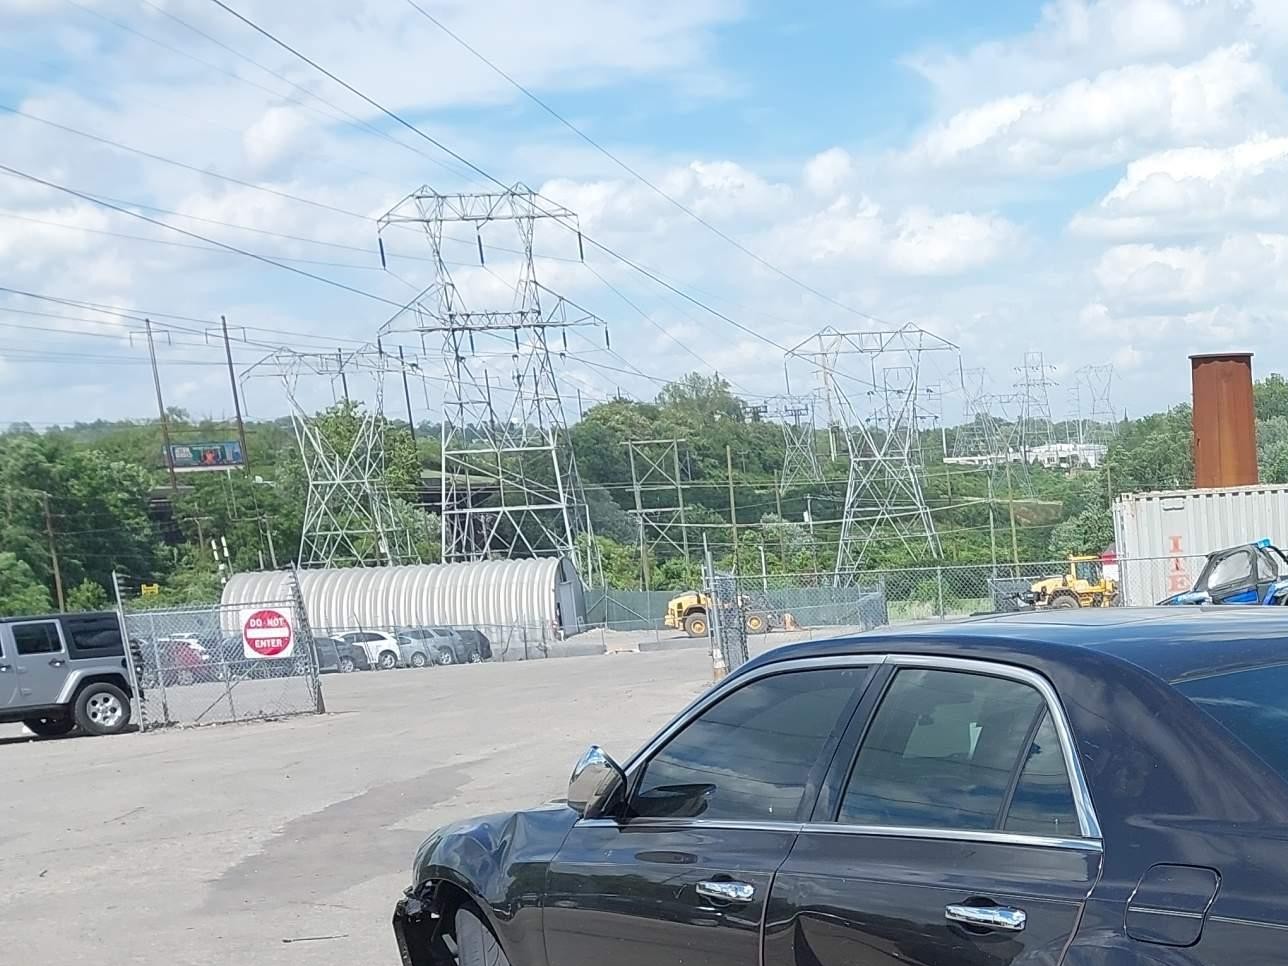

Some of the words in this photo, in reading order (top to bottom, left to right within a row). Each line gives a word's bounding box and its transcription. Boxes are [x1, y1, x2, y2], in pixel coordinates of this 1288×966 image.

[250, 618, 262, 627] DO
[267, 617, 285, 626] NOT
[255, 639, 282, 648] ENTER
